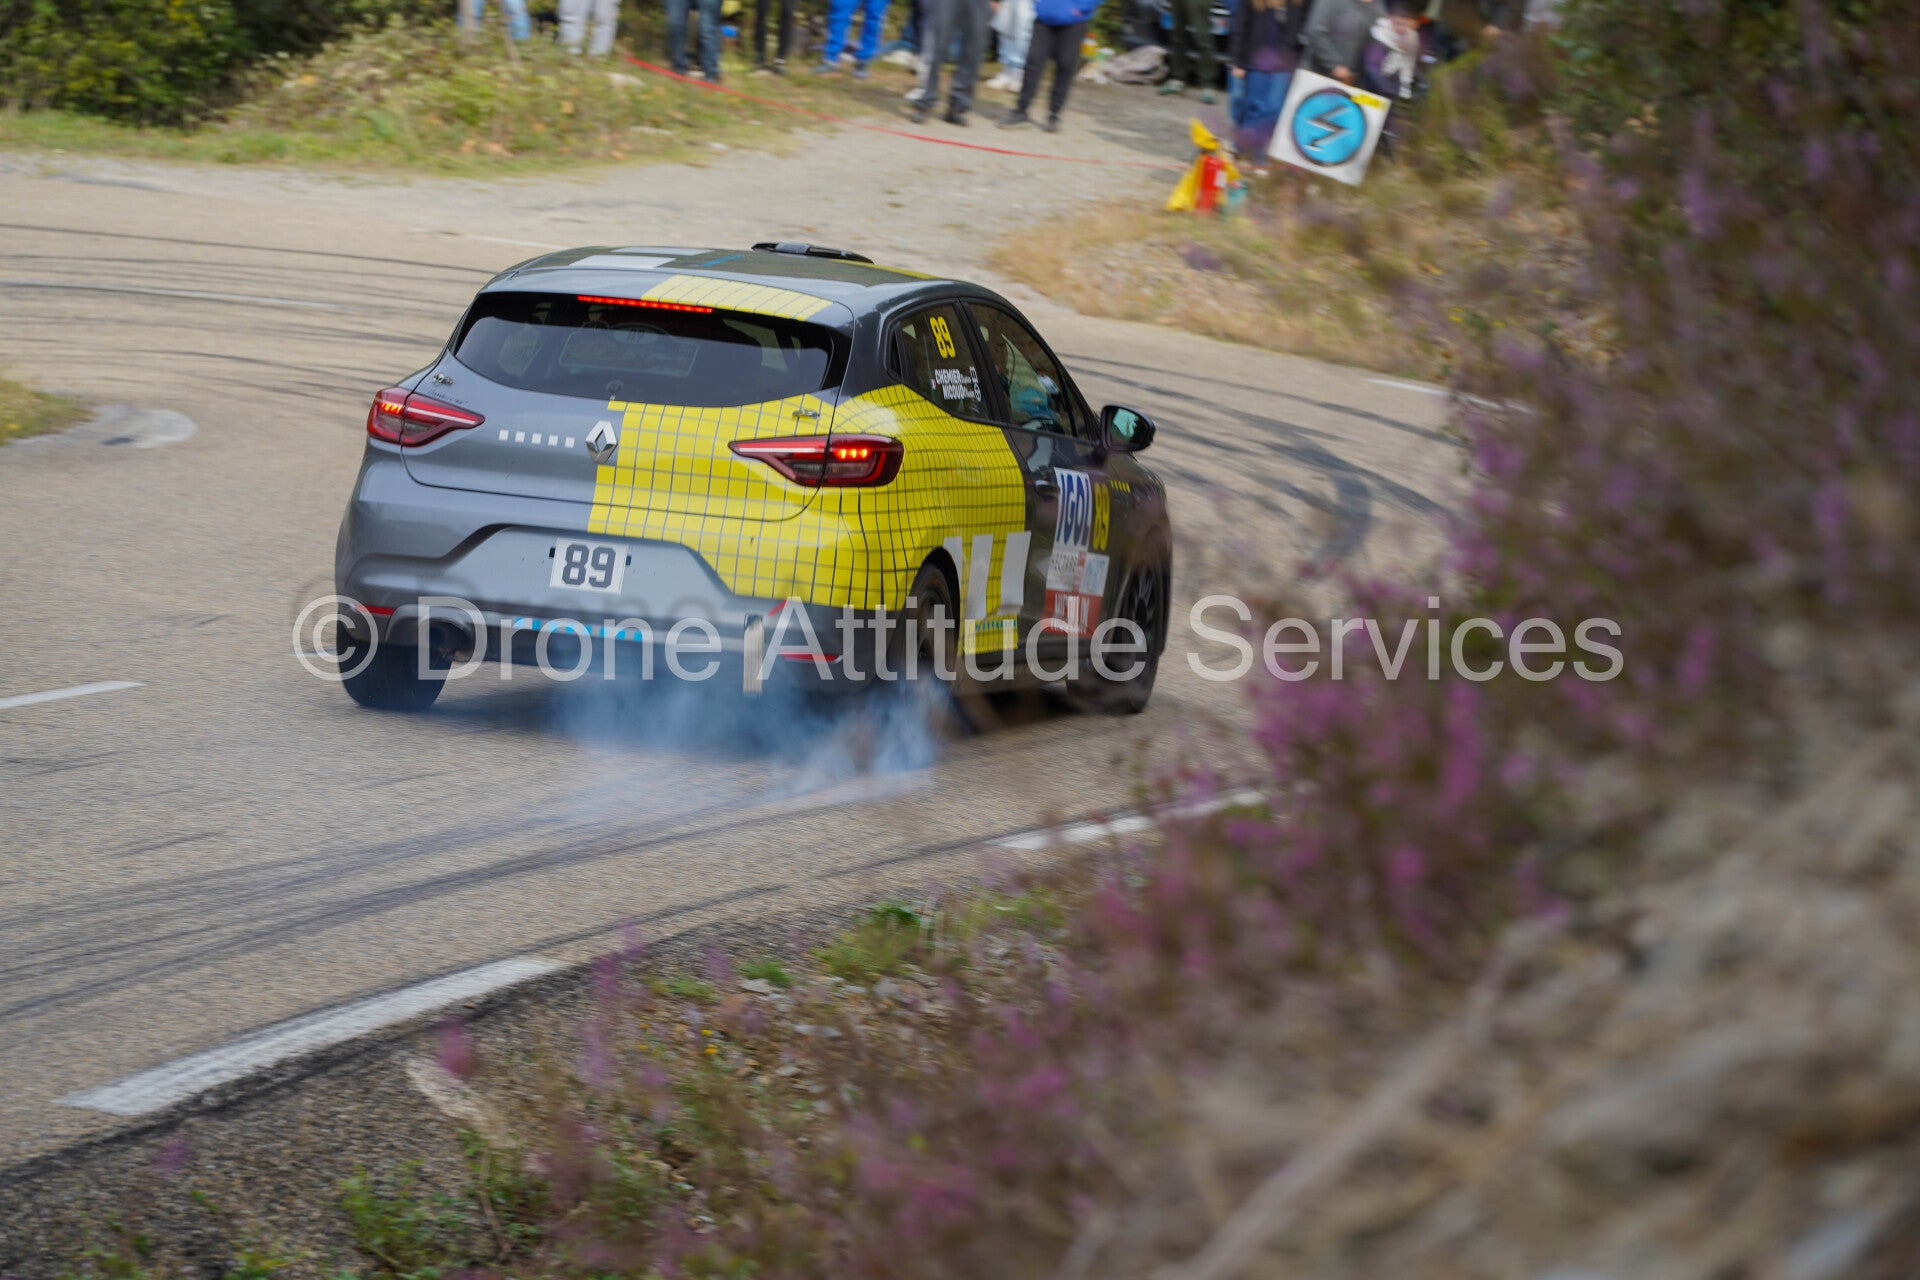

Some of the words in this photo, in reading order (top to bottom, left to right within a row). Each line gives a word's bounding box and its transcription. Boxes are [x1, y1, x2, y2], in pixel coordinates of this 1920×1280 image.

[930, 316, 956, 358] 89
[1056, 474, 1090, 546] IGOL
[1093, 482, 1109, 551] 89
[562, 544, 616, 588] 89
